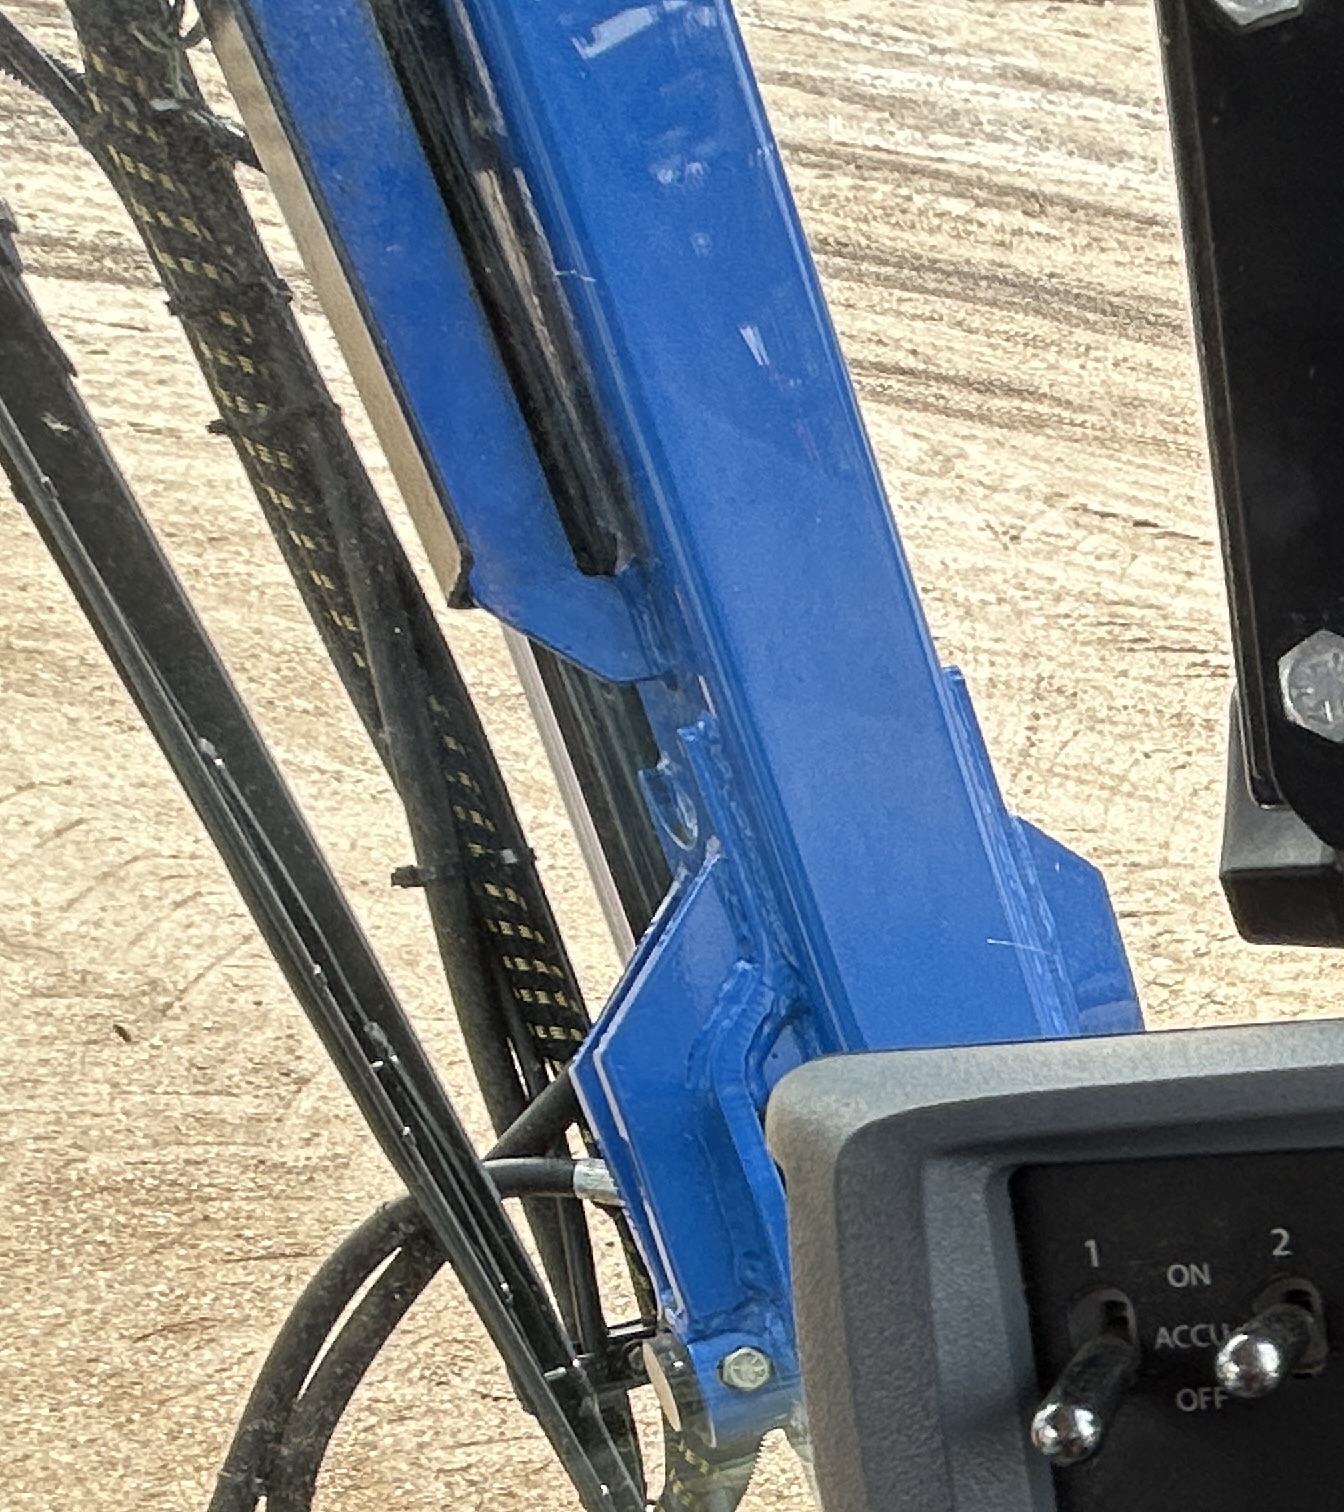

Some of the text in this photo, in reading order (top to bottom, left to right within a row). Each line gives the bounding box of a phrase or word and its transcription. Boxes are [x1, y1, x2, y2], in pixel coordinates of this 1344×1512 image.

[1085, 1240, 1099, 1267] 1
[1270, 1228, 1292, 1256] 2
[1167, 1263, 1211, 1288] ON
[1155, 1324, 1230, 1350] ACCU
[1176, 1387, 1228, 1412] OFF
